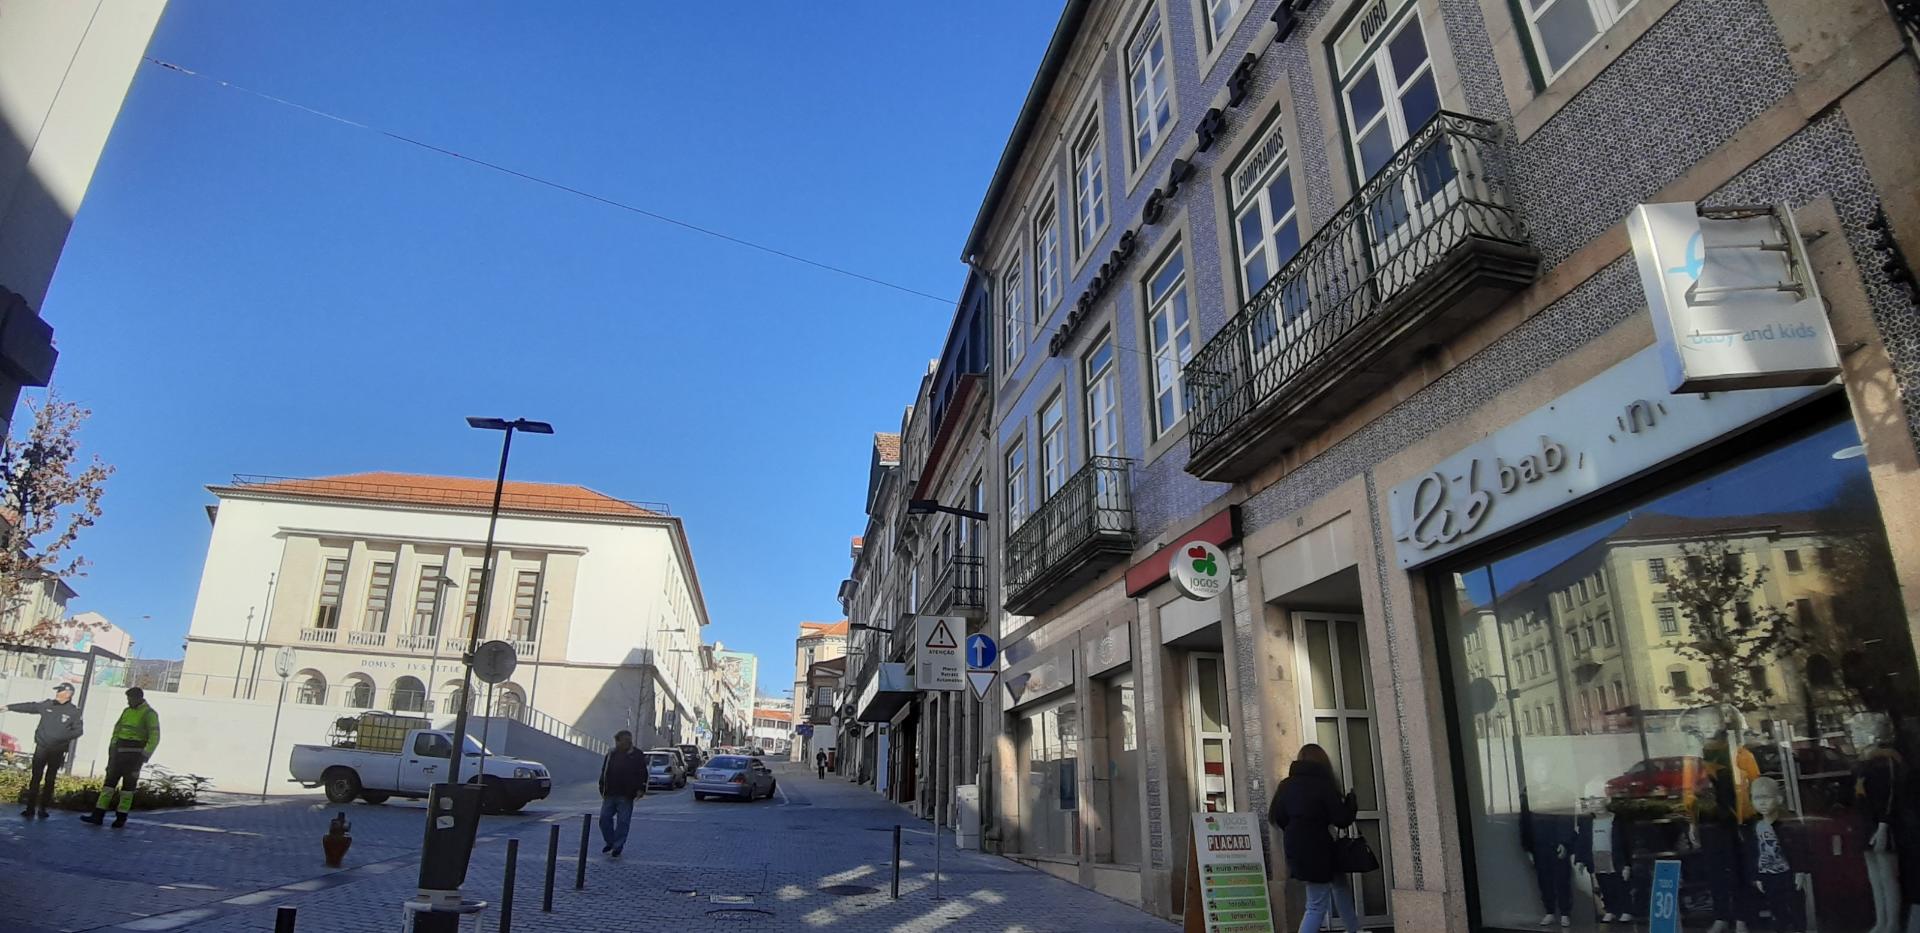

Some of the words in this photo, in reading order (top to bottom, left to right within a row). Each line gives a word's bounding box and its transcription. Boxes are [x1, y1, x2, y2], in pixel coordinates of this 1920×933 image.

[1361, 0, 1387, 44] OURO
[1239, 126, 1284, 195] COMPRAMOS
[1743, 324, 1774, 342] and
[1778, 321, 1817, 340] kids
[1190, 577, 1219, 589] JOGOS
[361, 659, 397, 668] DOMVS
[1207, 835, 1251, 850] PLACARD
[1654, 891, 1674, 919] 30
